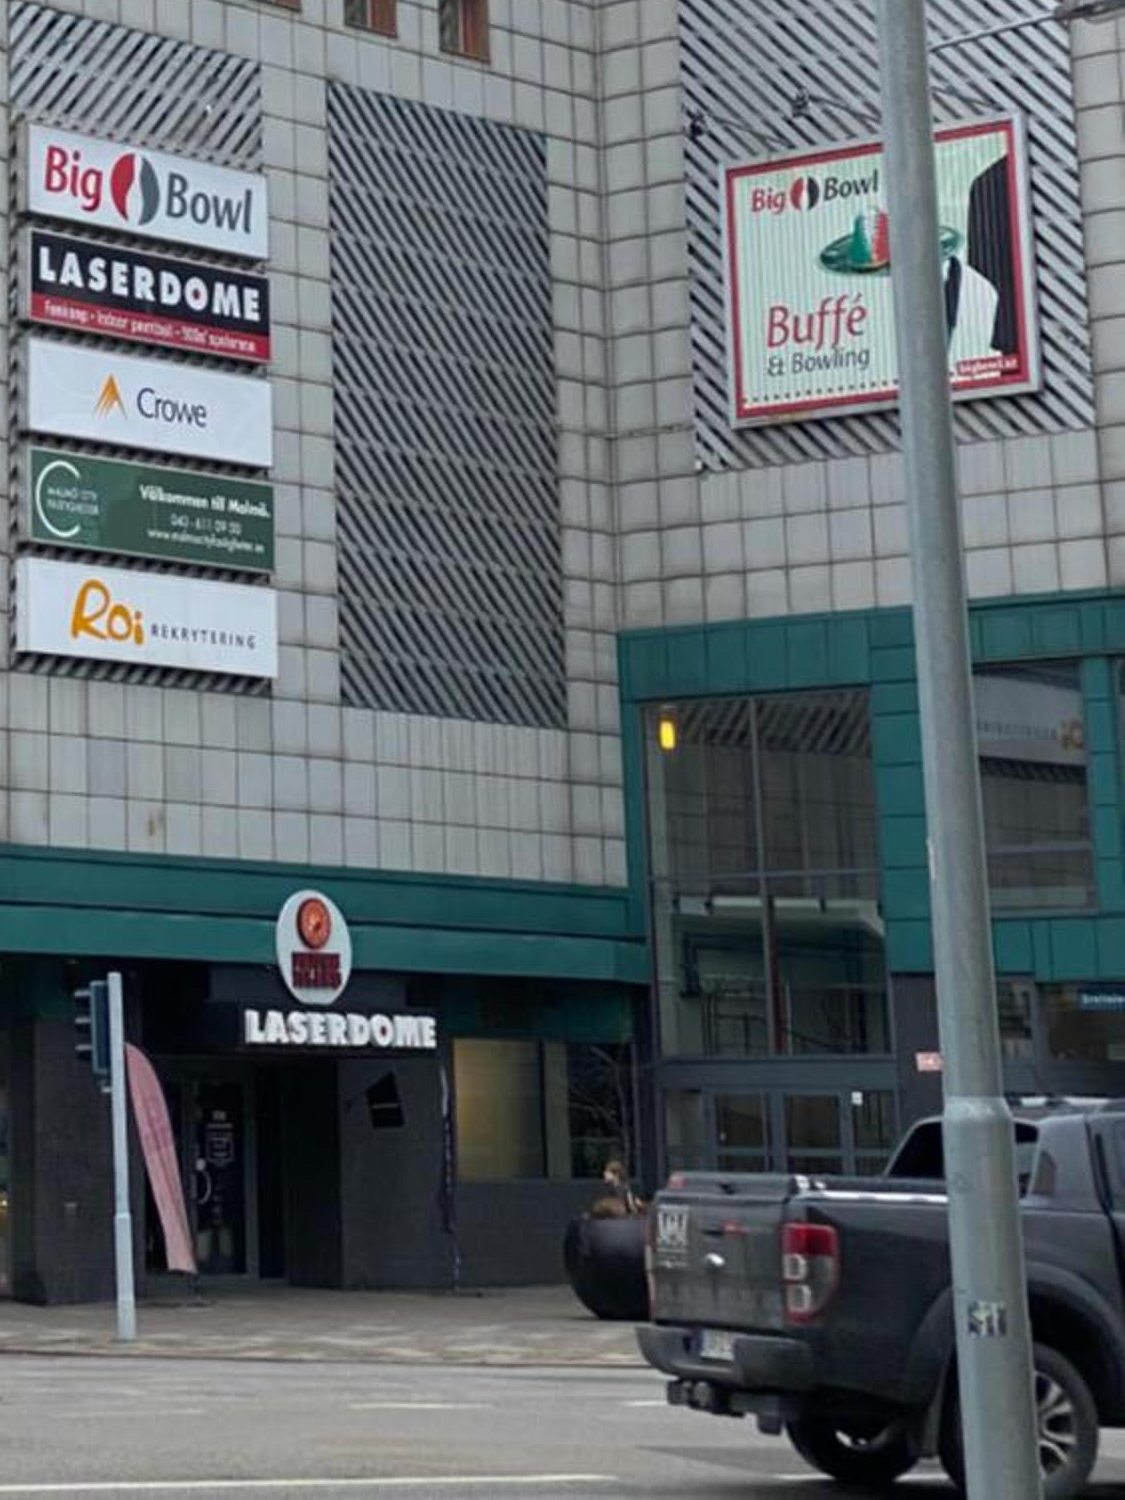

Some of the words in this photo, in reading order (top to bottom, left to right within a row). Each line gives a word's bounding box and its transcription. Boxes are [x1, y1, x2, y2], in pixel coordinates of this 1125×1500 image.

[44, 145, 103, 212] Big
[167, 173, 252, 234] Bowl
[751, 184, 786, 214] Big
[824, 169, 879, 201] Bowl
[38, 246, 261, 322] LASERDOME
[767, 291, 868, 351] Buffé
[767, 357, 786, 378] &
[792, 347, 871, 377] Bowling
[136, 387, 208, 428] Crowe
[139, 484, 208, 509] Välkommen
[210, 495, 226, 512] till
[71, 579, 145, 645] Roi
[151, 623, 257, 650] REKRYTERING
[244, 1009, 437, 1049] LASERDOME
